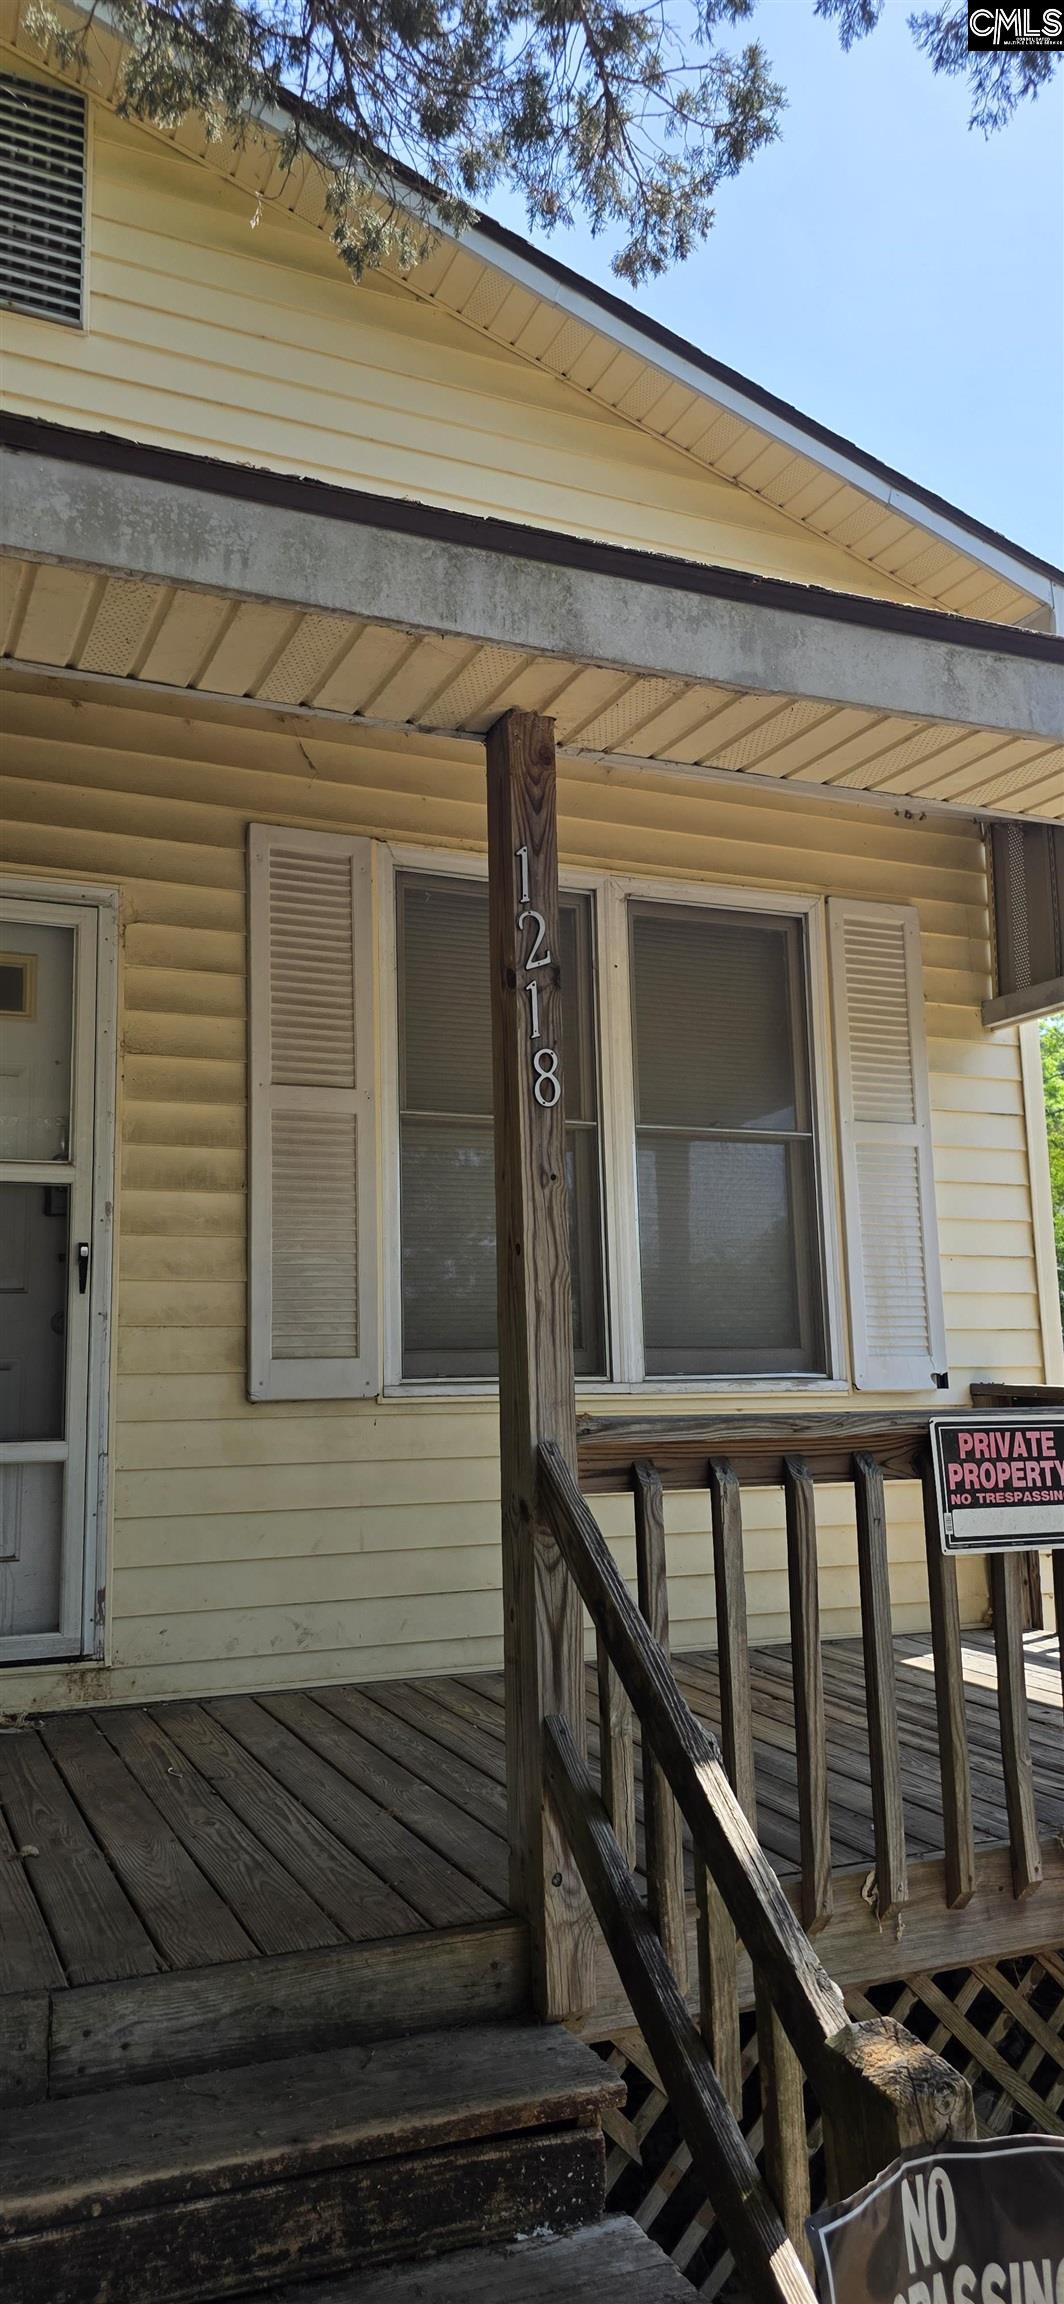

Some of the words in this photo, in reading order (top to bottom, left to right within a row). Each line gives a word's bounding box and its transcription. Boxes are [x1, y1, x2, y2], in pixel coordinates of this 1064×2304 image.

[515, 846, 561, 1107] 1218
[958, 1431, 1057, 1459] PRIVATE
[948, 1460, 1064, 1490] PROPERTY
[951, 1493, 972, 1505] NO
[976, 1490, 1064, 1504] TRESPASSIN
[902, 2166, 956, 2274] NO
